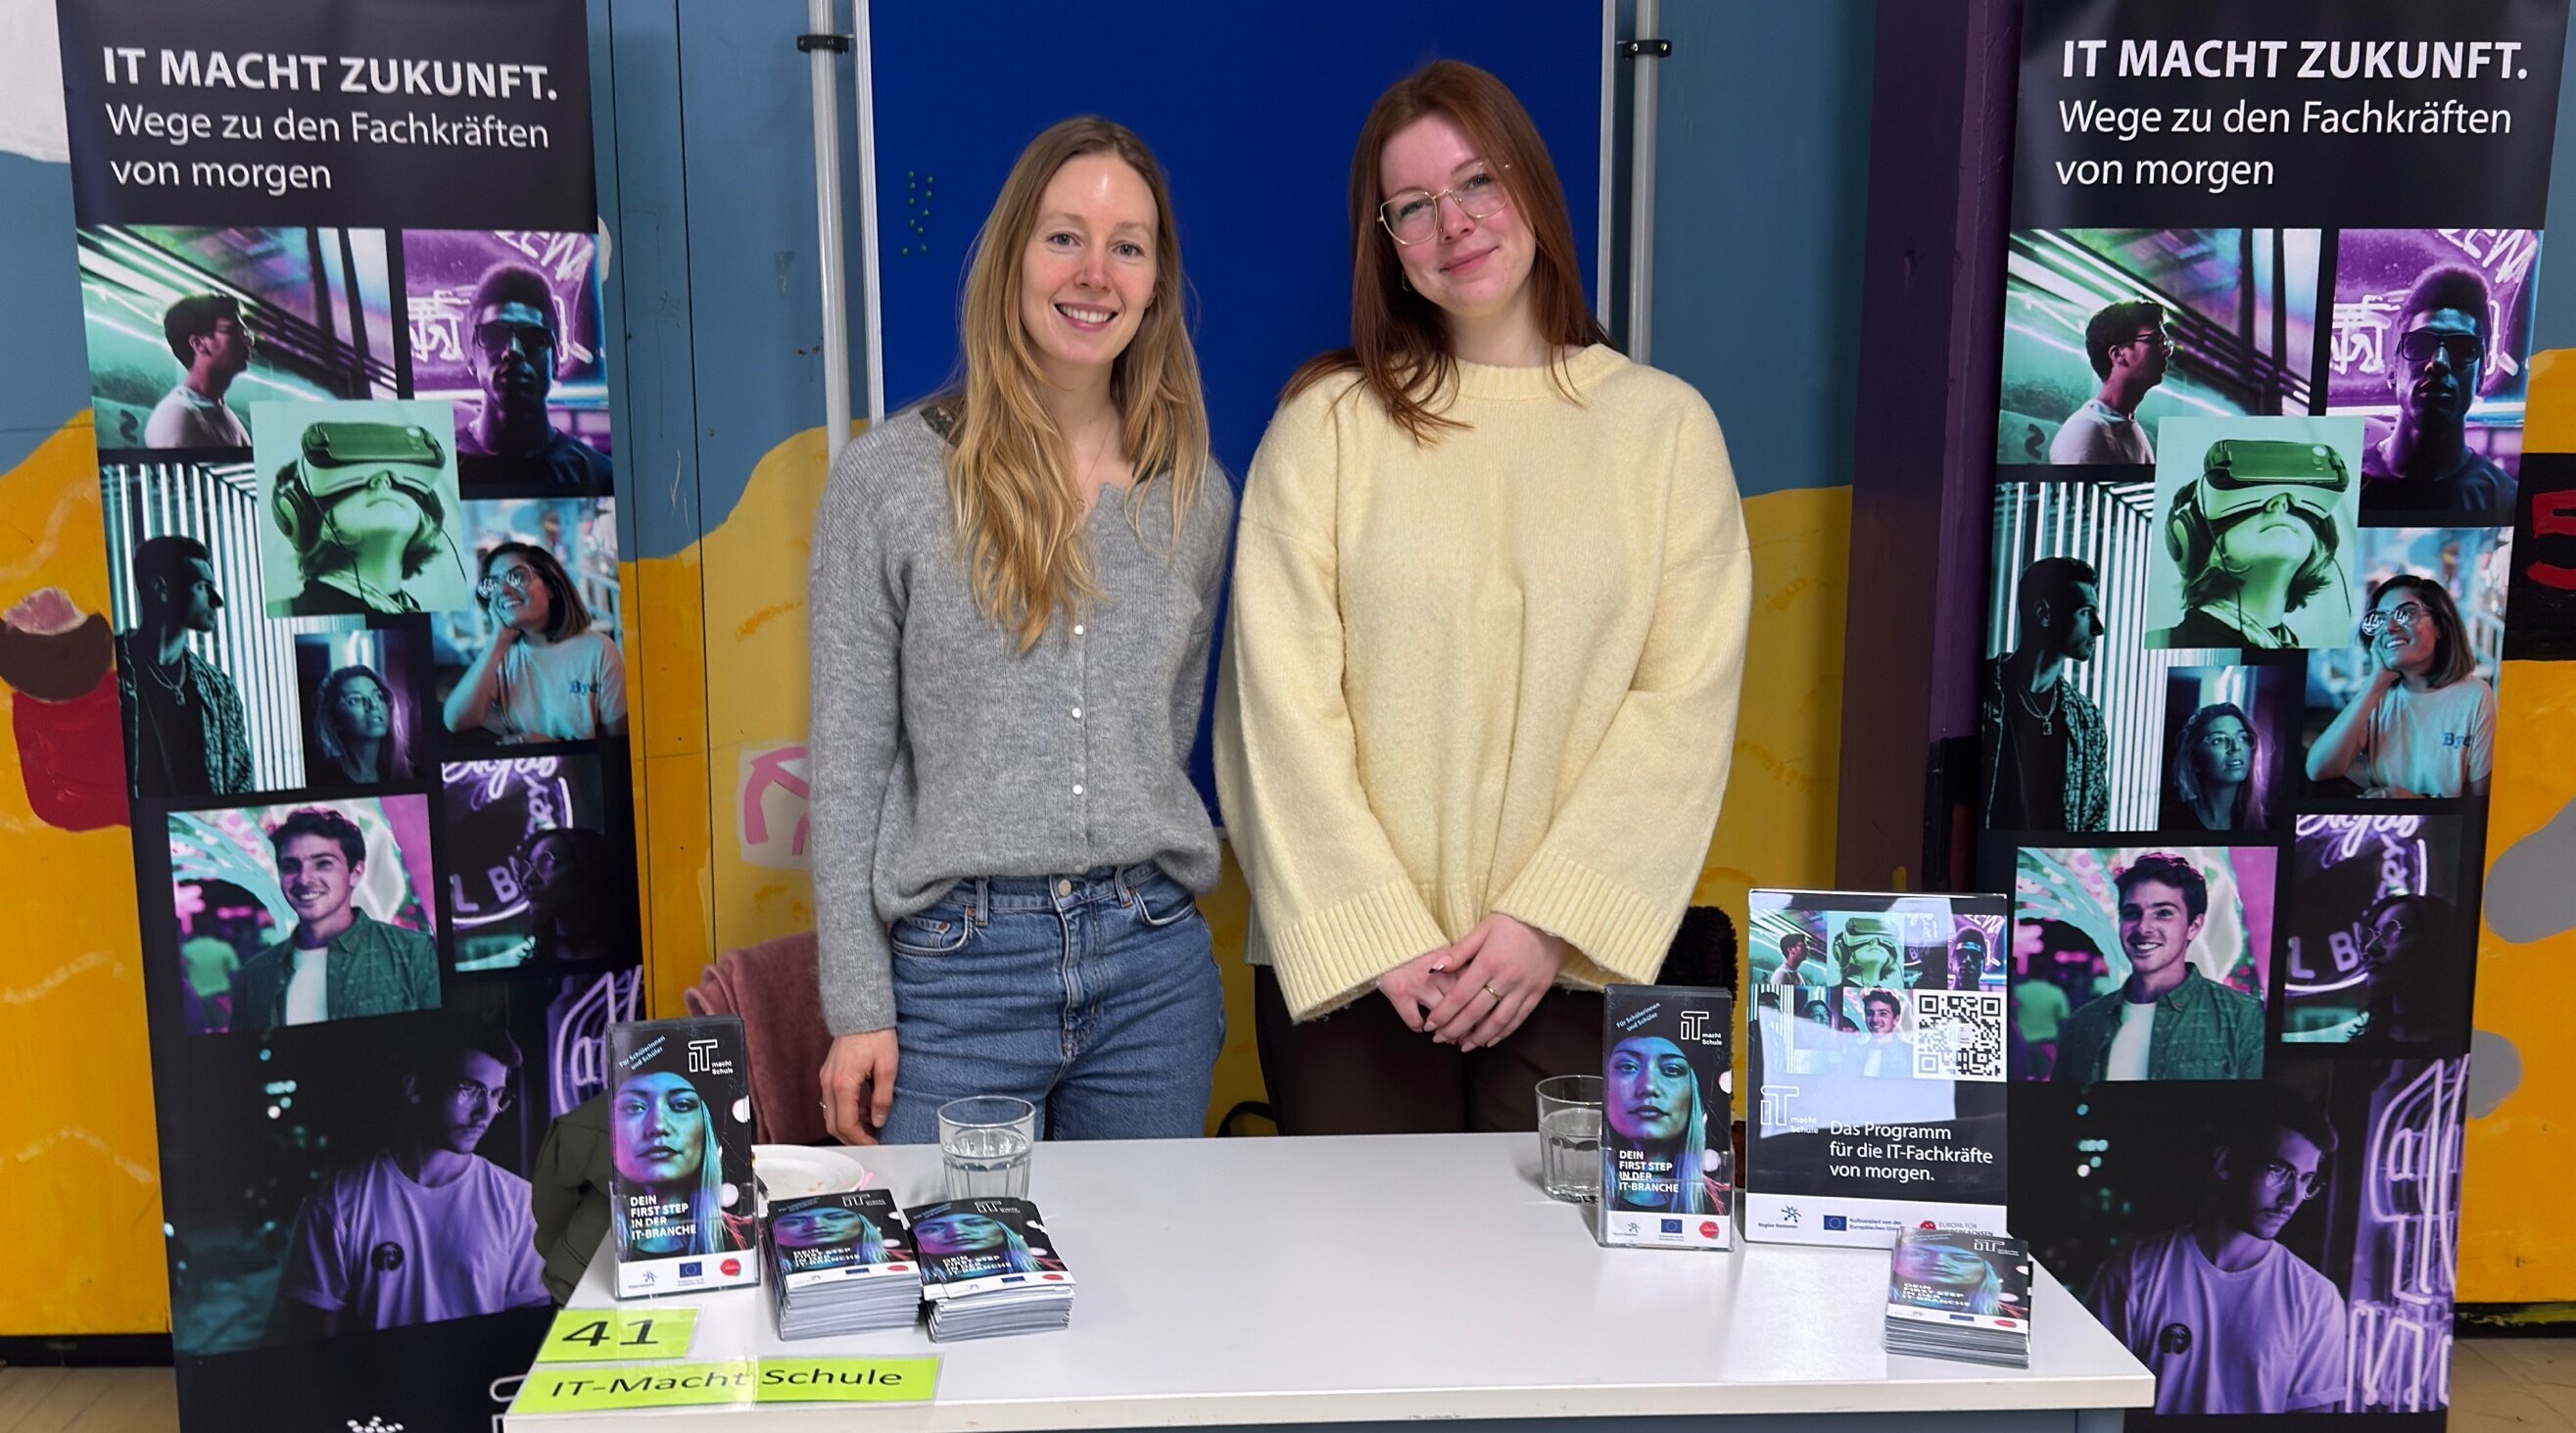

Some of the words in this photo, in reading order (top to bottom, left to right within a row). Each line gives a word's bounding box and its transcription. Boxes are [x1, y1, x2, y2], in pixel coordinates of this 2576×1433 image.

[2063, 39, 2107, 78] IT
[2118, 40, 2288, 78] MACHT
[2297, 41, 2528, 79] ZUKUNFT.
[104, 46, 147, 84] IT
[161, 49, 328, 91] MACHT
[340, 57, 558, 101] ZUKUNFT.
[105, 103, 212, 146] Wege
[221, 116, 262, 140] zu
[273, 108, 340, 142] den
[352, 111, 549, 149] Fachkräften
[2058, 100, 2162, 141] Wege
[2171, 109, 2212, 133] zu
[2222, 99, 2290, 133] den
[2303, 100, 2511, 134] Fachkräften
[110, 160, 180, 186] von
[191, 162, 331, 196] morgen
[2056, 160, 2123, 185] von
[2135, 160, 2274, 194] morgen
[1626, 1022, 1639, 1031] und
[1638, 1012, 1658, 1027] Schüler
[630, 1061, 643, 1071] und
[1830, 1121, 1861, 1135] Das
[1865, 1121, 1952, 1142] Programm
[1619, 1150, 1644, 1160] DEIN
[1830, 1141, 1854, 1157] für
[1857, 1143, 1883, 1158] die
[1886, 1144, 1994, 1164] IT-Fachkräfte
[1619, 1161, 1646, 1170] FIRST
[1647, 1162, 1673, 1171] STEP
[1619, 1171, 1630, 1180] IN
[1632, 1171, 1652, 1180] DER
[1830, 1165, 1861, 1177] von
[1865, 1167, 1935, 1184] morgen.
[1619, 1182, 1680, 1193] IT-BRANCHE
[630, 1194, 657, 1207] DEIN
[630, 1206, 660, 1218] FIRST
[662, 1202, 689, 1215] STEP
[631, 1218, 644, 1229] IN
[645, 1217, 667, 1227] DER
[632, 1224, 697, 1240] IT-BRANCHE
[561, 1318, 659, 1347] 41
[551, 1370, 747, 1397] IT-Macht
[761, 1368, 903, 1387] Schule
